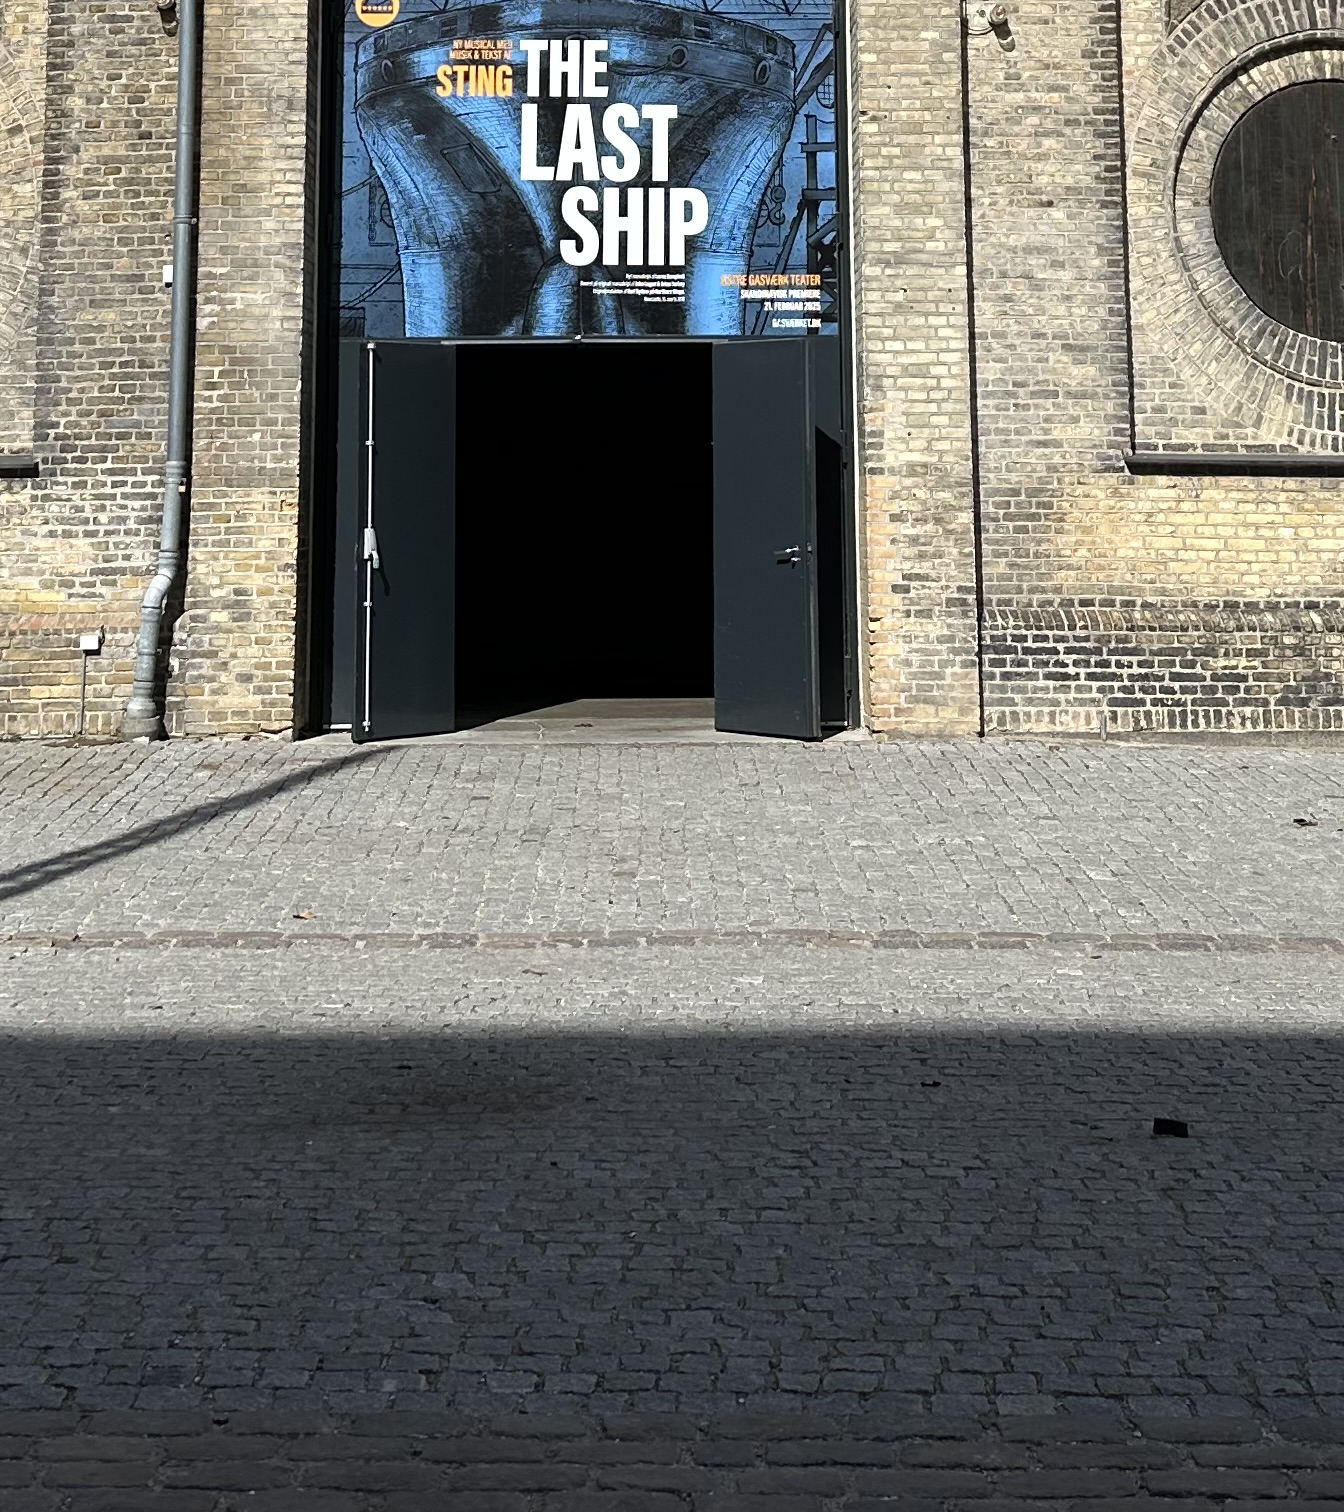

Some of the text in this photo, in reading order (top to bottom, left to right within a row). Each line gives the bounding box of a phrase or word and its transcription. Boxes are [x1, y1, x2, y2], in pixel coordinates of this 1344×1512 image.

[481, 50, 502, 59] TEKST
[520, 39, 608, 98] THE
[436, 64, 513, 97] STING
[520, 103, 678, 182] LAST
[559, 186, 709, 267] SHIP
[789, 274, 821, 286] TEATER
